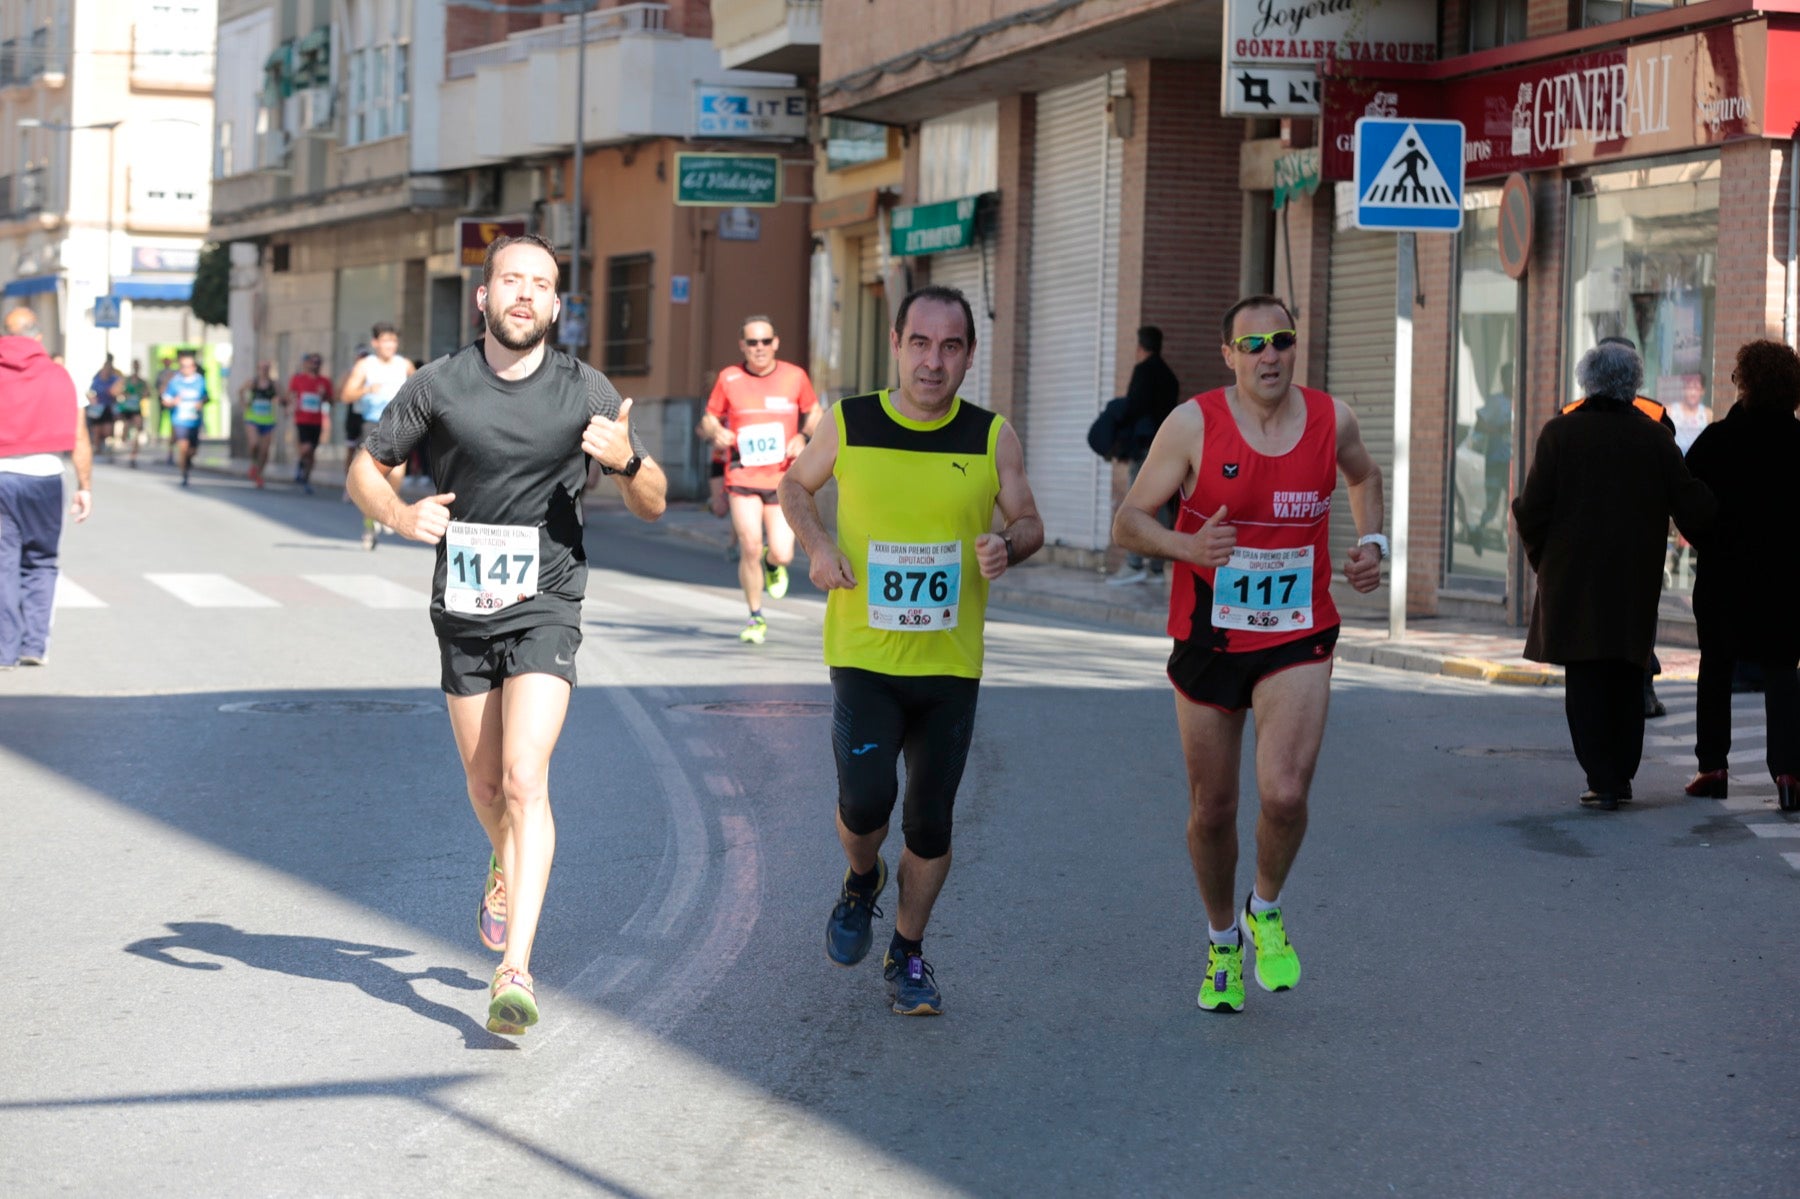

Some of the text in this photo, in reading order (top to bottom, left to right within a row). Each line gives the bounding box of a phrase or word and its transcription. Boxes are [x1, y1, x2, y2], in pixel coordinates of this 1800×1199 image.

[1236, 39, 1437, 62] GONZALEZ VAZQUEZ
[1534, 55, 1672, 152] GENERALI
[1697, 95, 1751, 133] Seguros
[748, 437, 777, 453] 102
[1273, 491, 1319, 502] RUNNING
[891, 545, 907, 554] GRAN
[908, 546, 931, 555] PREMIO
[932, 546, 939, 554] DE
[454, 551, 534, 585] 1147
[883, 571, 948, 602] 876
[1233, 574, 1298, 605] 117
